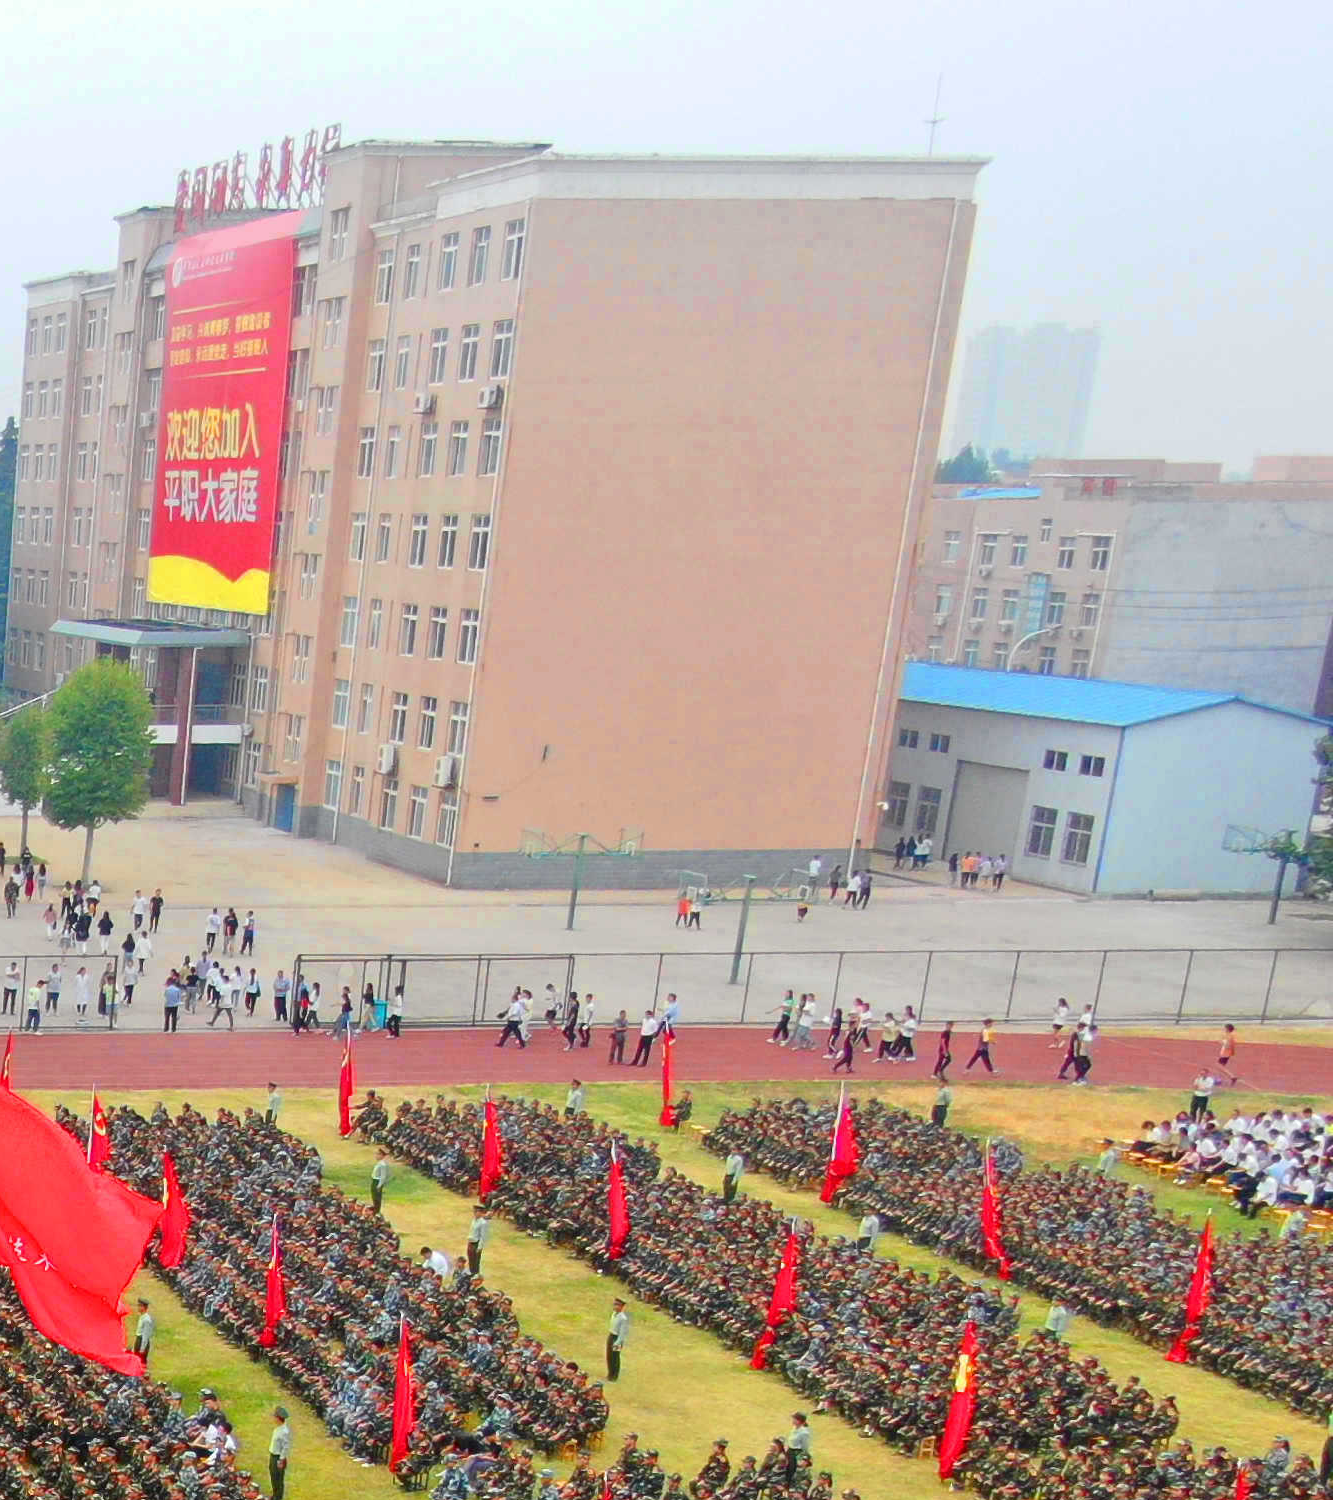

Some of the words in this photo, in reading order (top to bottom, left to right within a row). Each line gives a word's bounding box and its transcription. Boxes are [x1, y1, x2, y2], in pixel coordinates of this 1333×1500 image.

[164, 402, 261, 462] 欢迎您加入
[163, 466, 261, 524] 平职大家庭
